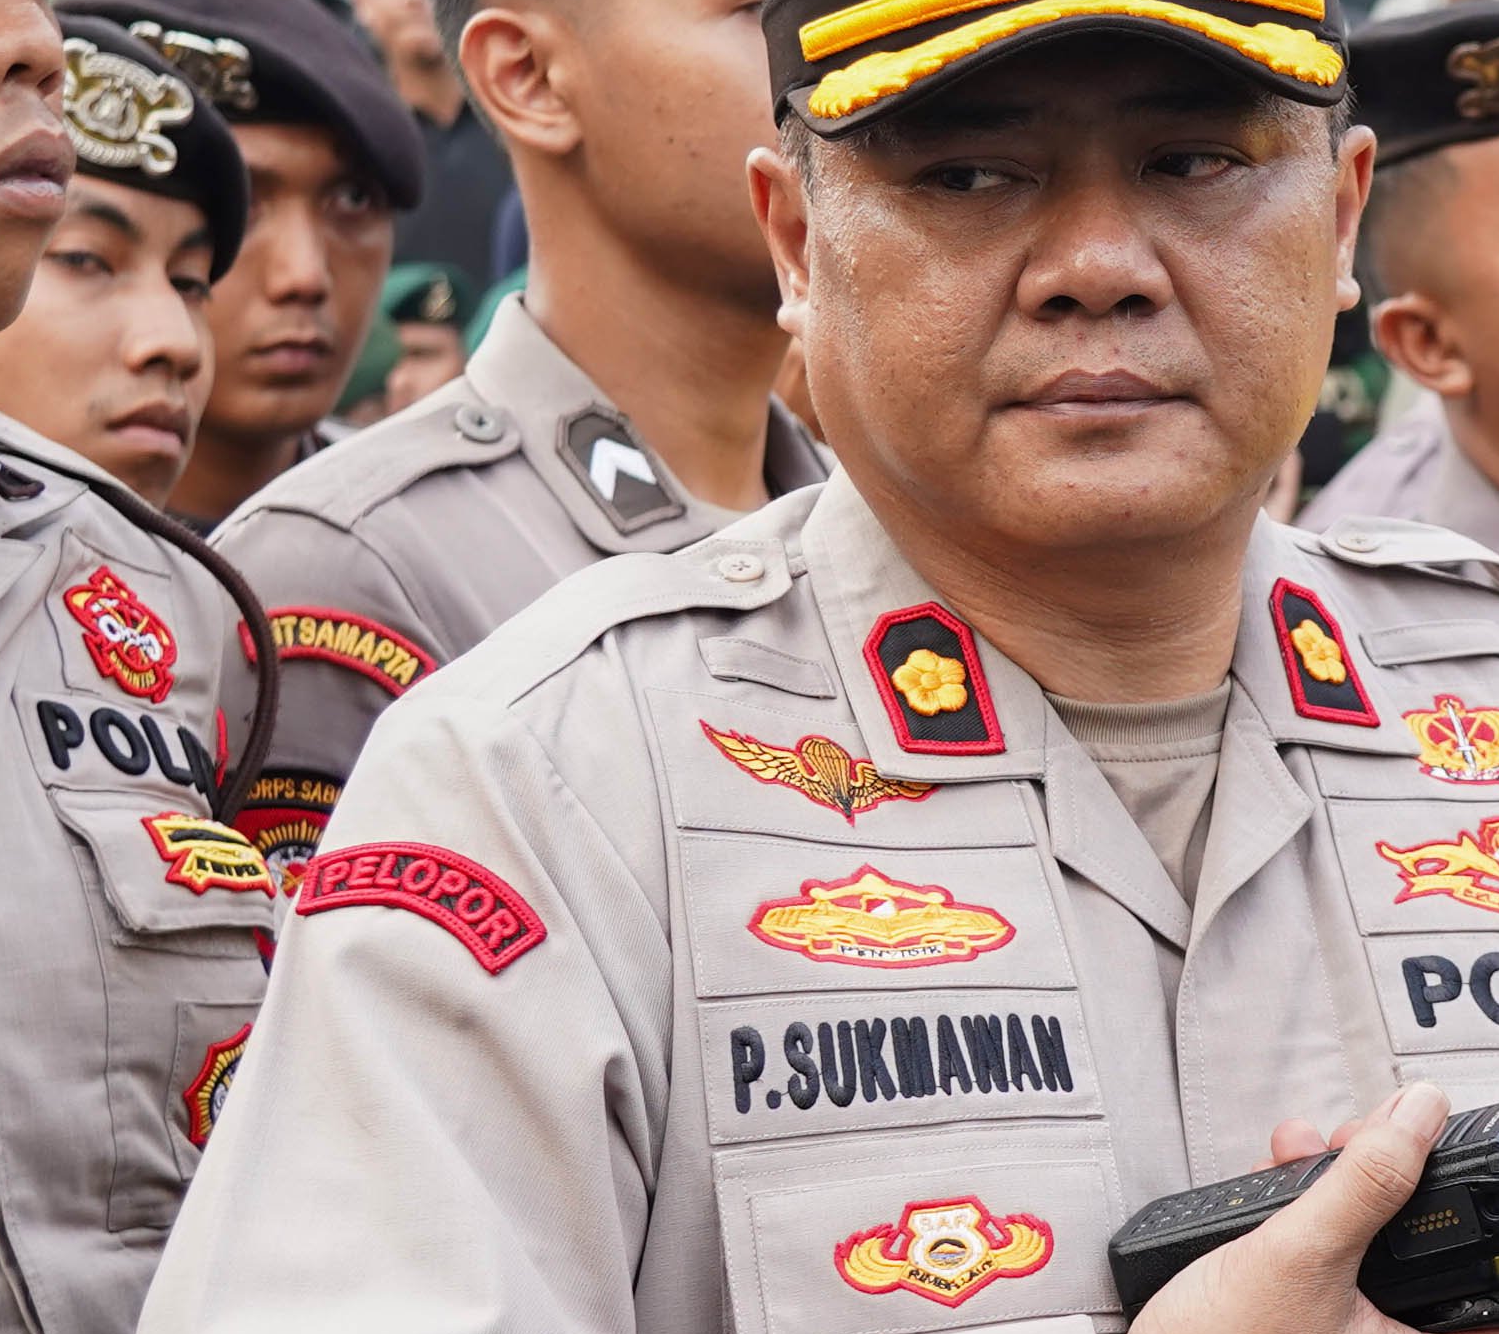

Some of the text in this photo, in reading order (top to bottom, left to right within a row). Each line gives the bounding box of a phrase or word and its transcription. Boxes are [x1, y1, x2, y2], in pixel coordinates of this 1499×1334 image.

[299, 617, 419, 686] SAMAPTA
[247, 779, 343, 805] ORPS SAB
[321, 853, 520, 950] PELOPOR
[730, 1013, 1075, 1115] P.SUKMAWAN
